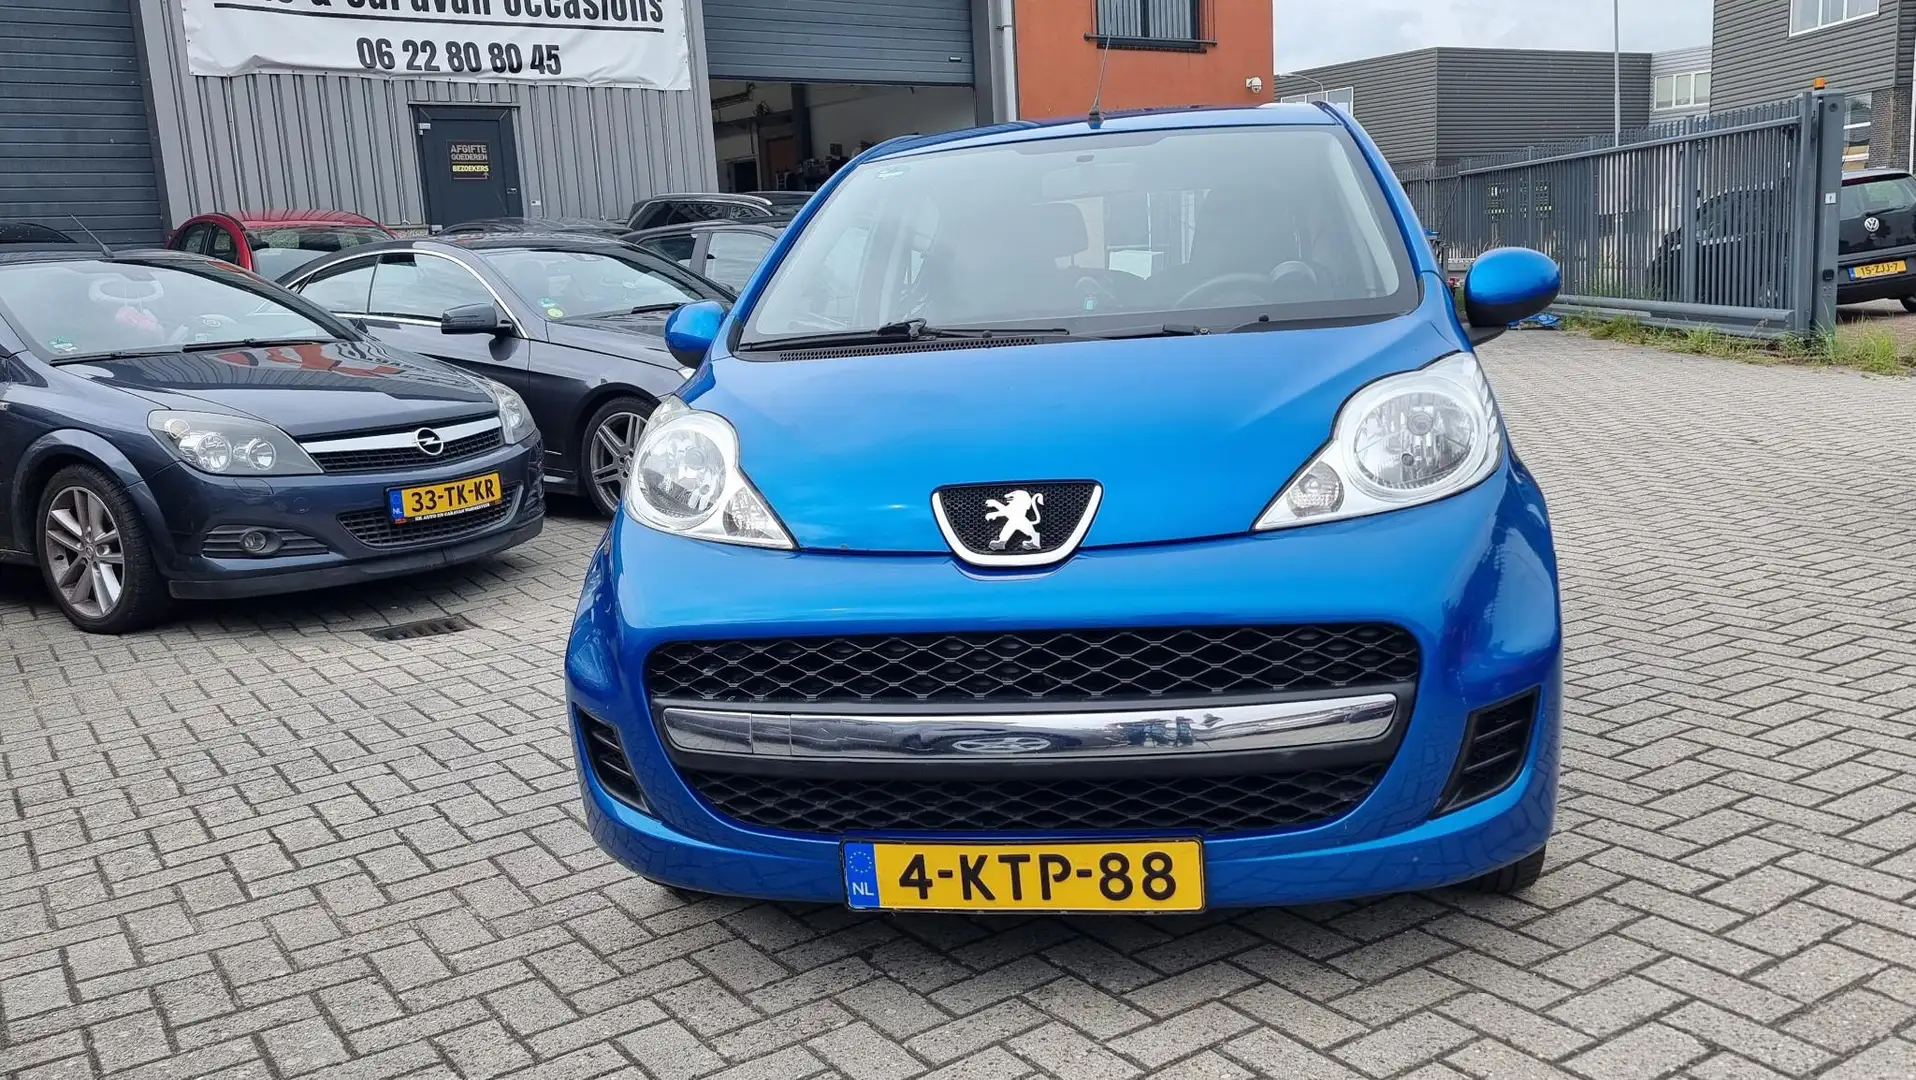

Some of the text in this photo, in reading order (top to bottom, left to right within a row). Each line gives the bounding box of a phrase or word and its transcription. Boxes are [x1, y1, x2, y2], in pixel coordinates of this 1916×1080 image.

[356, 37, 562, 75] 06 22 80 80 45
[450, 144, 487, 153] AFGIFTE
[451, 153, 488, 161] GOEDEREN
[411, 479, 495, 512] 33-TK-KR
[899, 851, 1176, 901] 4-KTP-88
[853, 882, 874, 896] NL
